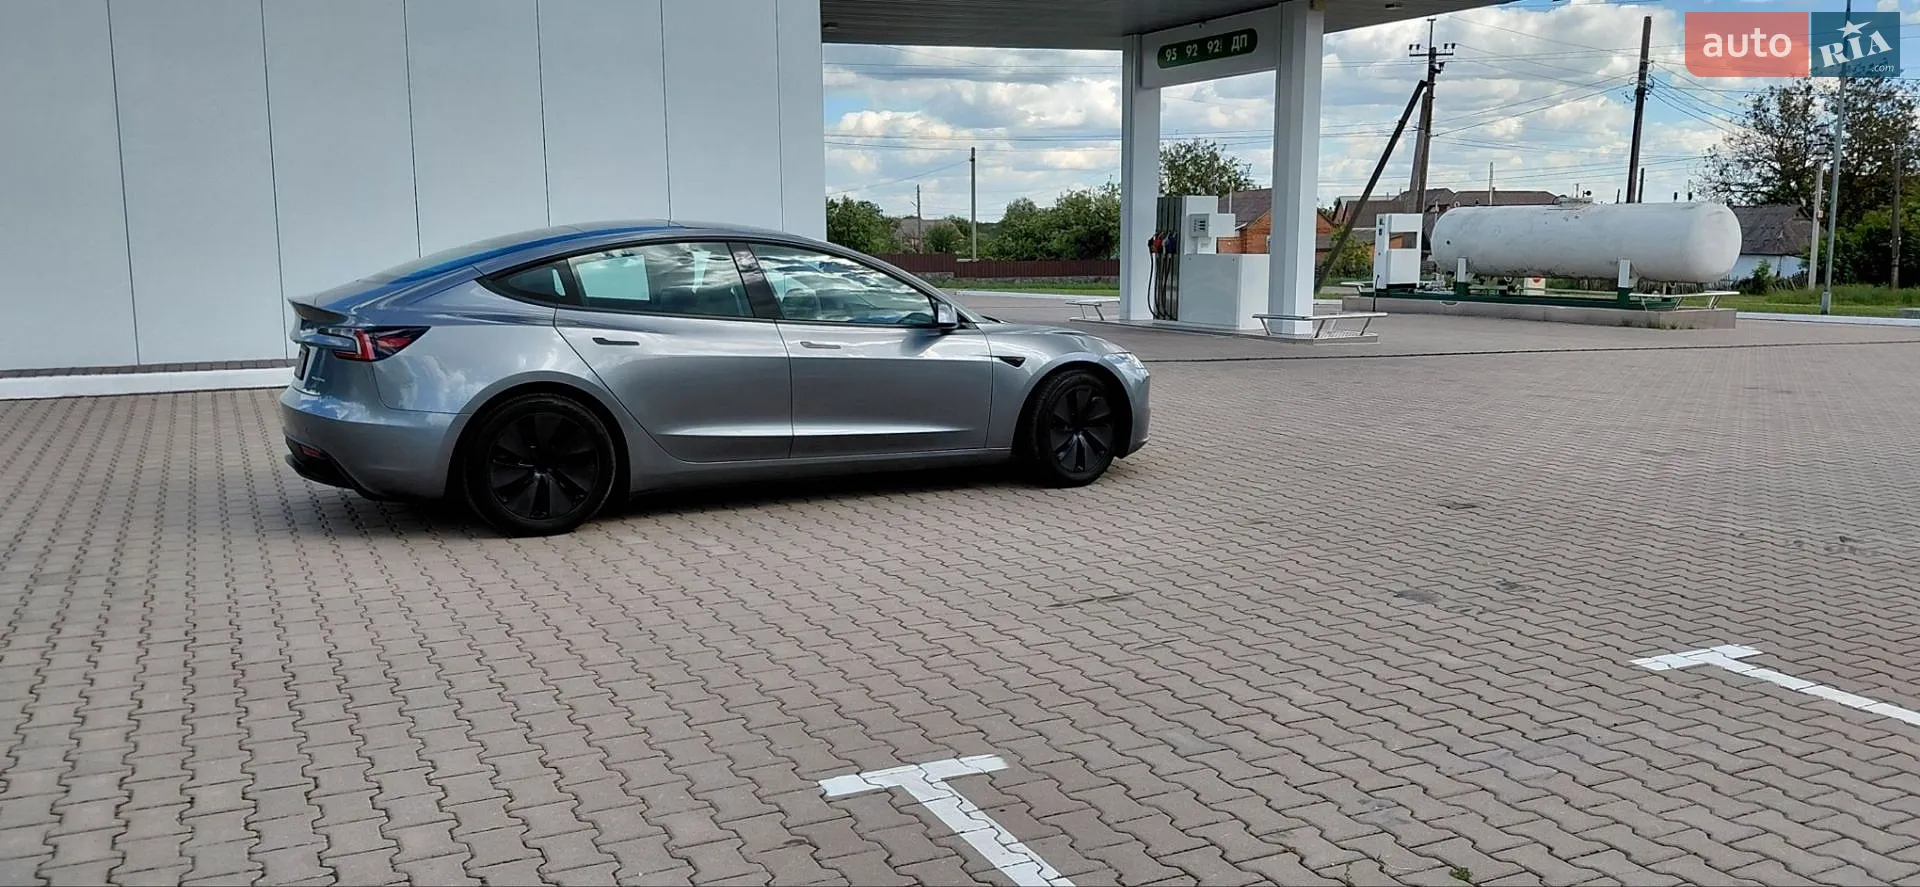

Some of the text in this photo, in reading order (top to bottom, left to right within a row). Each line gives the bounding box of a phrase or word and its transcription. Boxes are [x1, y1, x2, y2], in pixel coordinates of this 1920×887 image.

[1165, 48, 1177, 62] 95
[1186, 44, 1198, 57] 92
[1231, 34, 1248, 52] ДП
